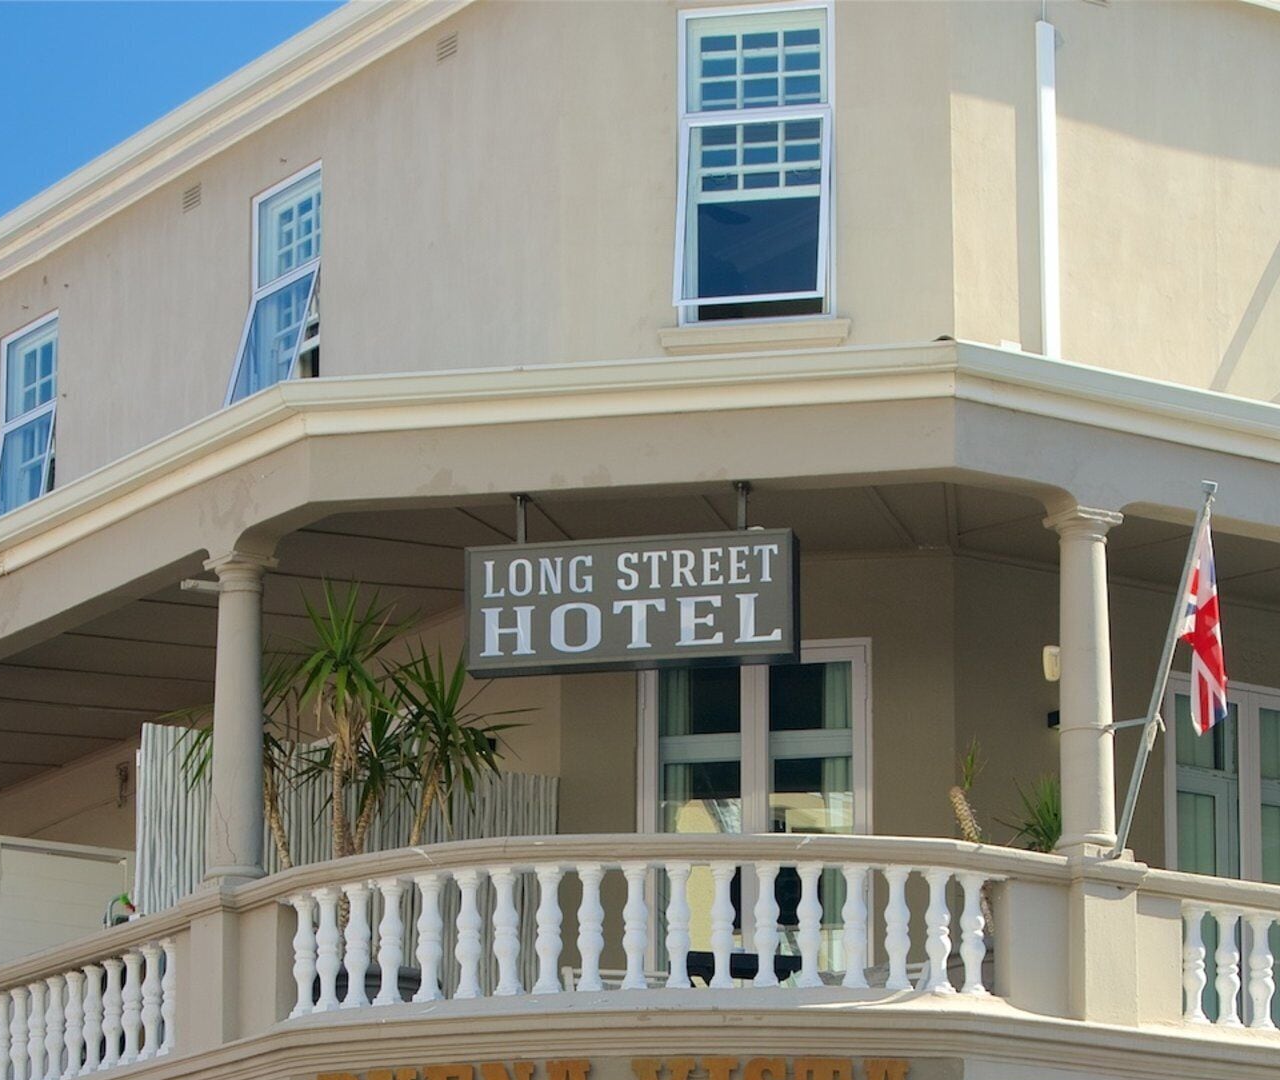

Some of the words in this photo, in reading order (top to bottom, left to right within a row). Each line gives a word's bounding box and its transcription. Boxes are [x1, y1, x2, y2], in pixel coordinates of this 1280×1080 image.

[482, 554, 594, 599] LONG
[617, 544, 779, 592] STREET
[479, 592, 783, 658] HOTEL
